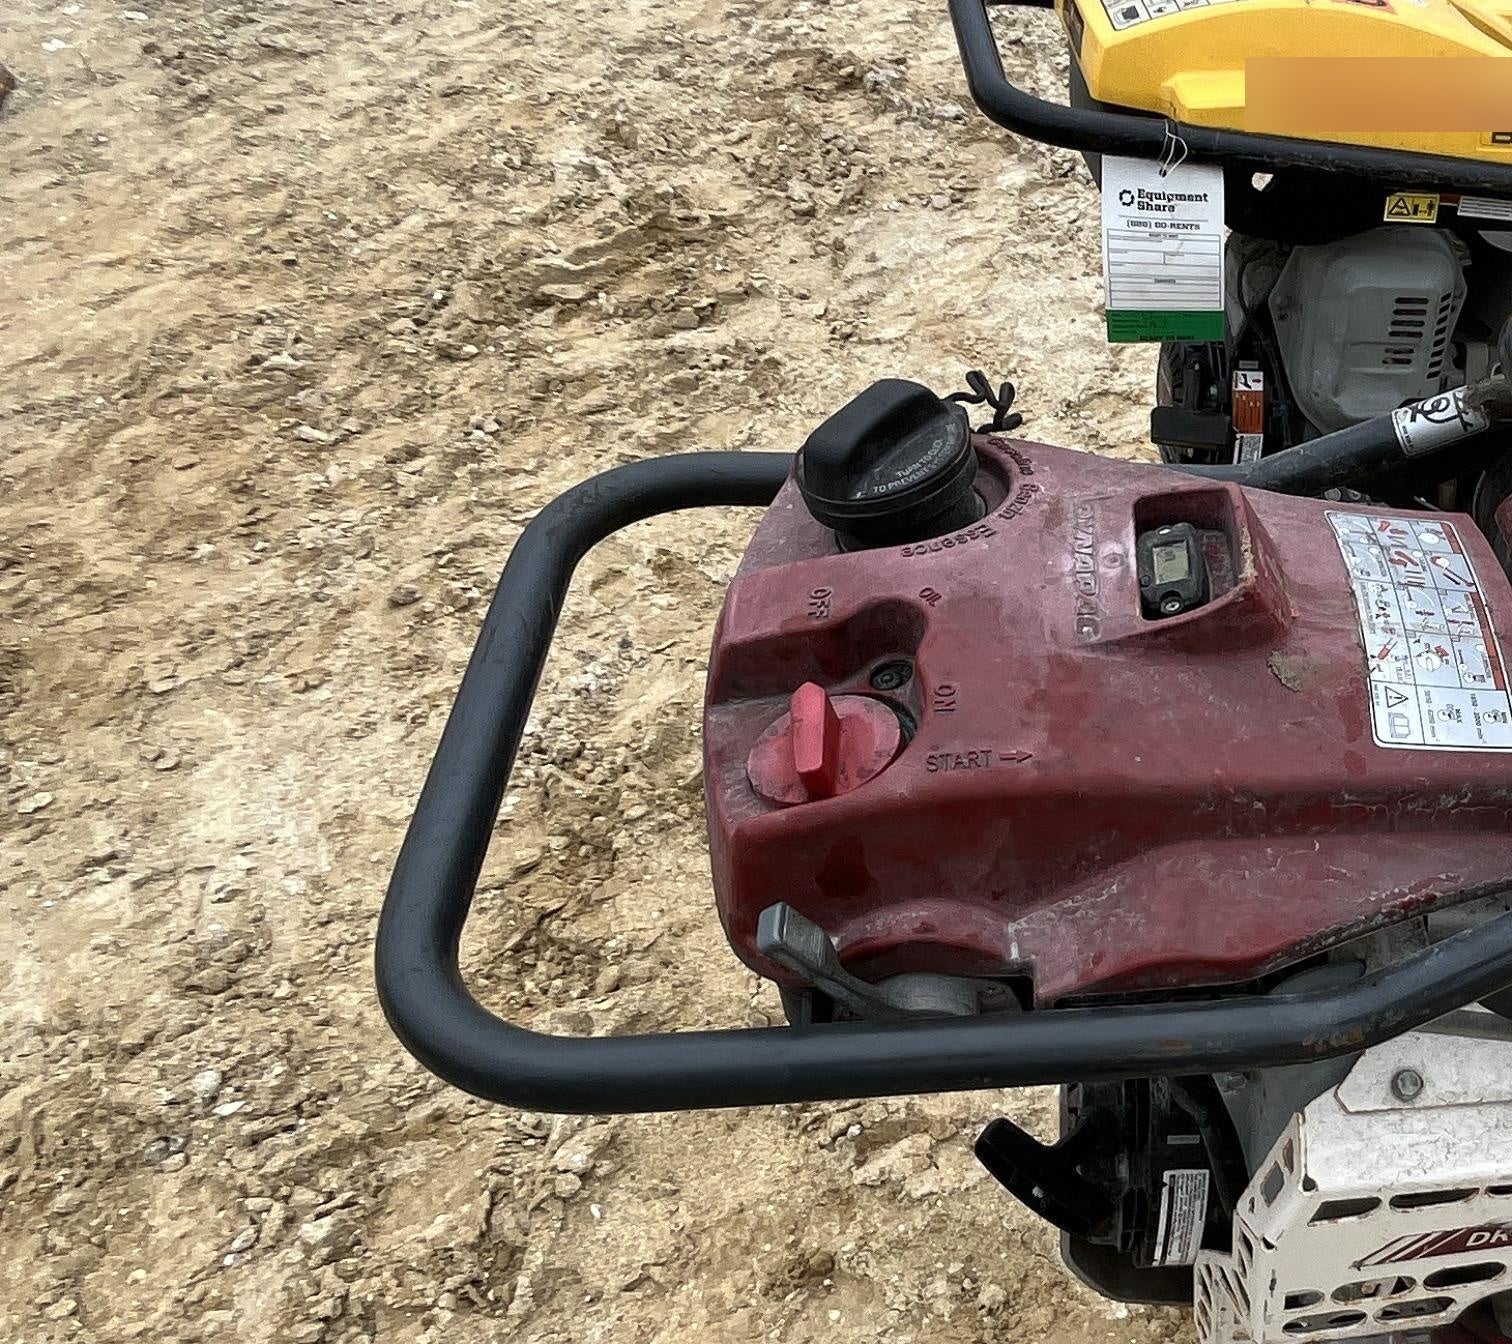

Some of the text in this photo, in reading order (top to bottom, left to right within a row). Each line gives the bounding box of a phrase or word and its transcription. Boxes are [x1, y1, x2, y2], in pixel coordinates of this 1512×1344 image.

[1137, 188, 1209, 203] Equipment
[1137, 201, 1175, 212] Share
[998, 483, 1039, 520] Benzin
[901, 524, 998, 557] Essence
[807, 587, 833, 619] OFF
[918, 586, 943, 607] OIL
[934, 684, 956, 713] ON
[926, 749, 993, 773] START
